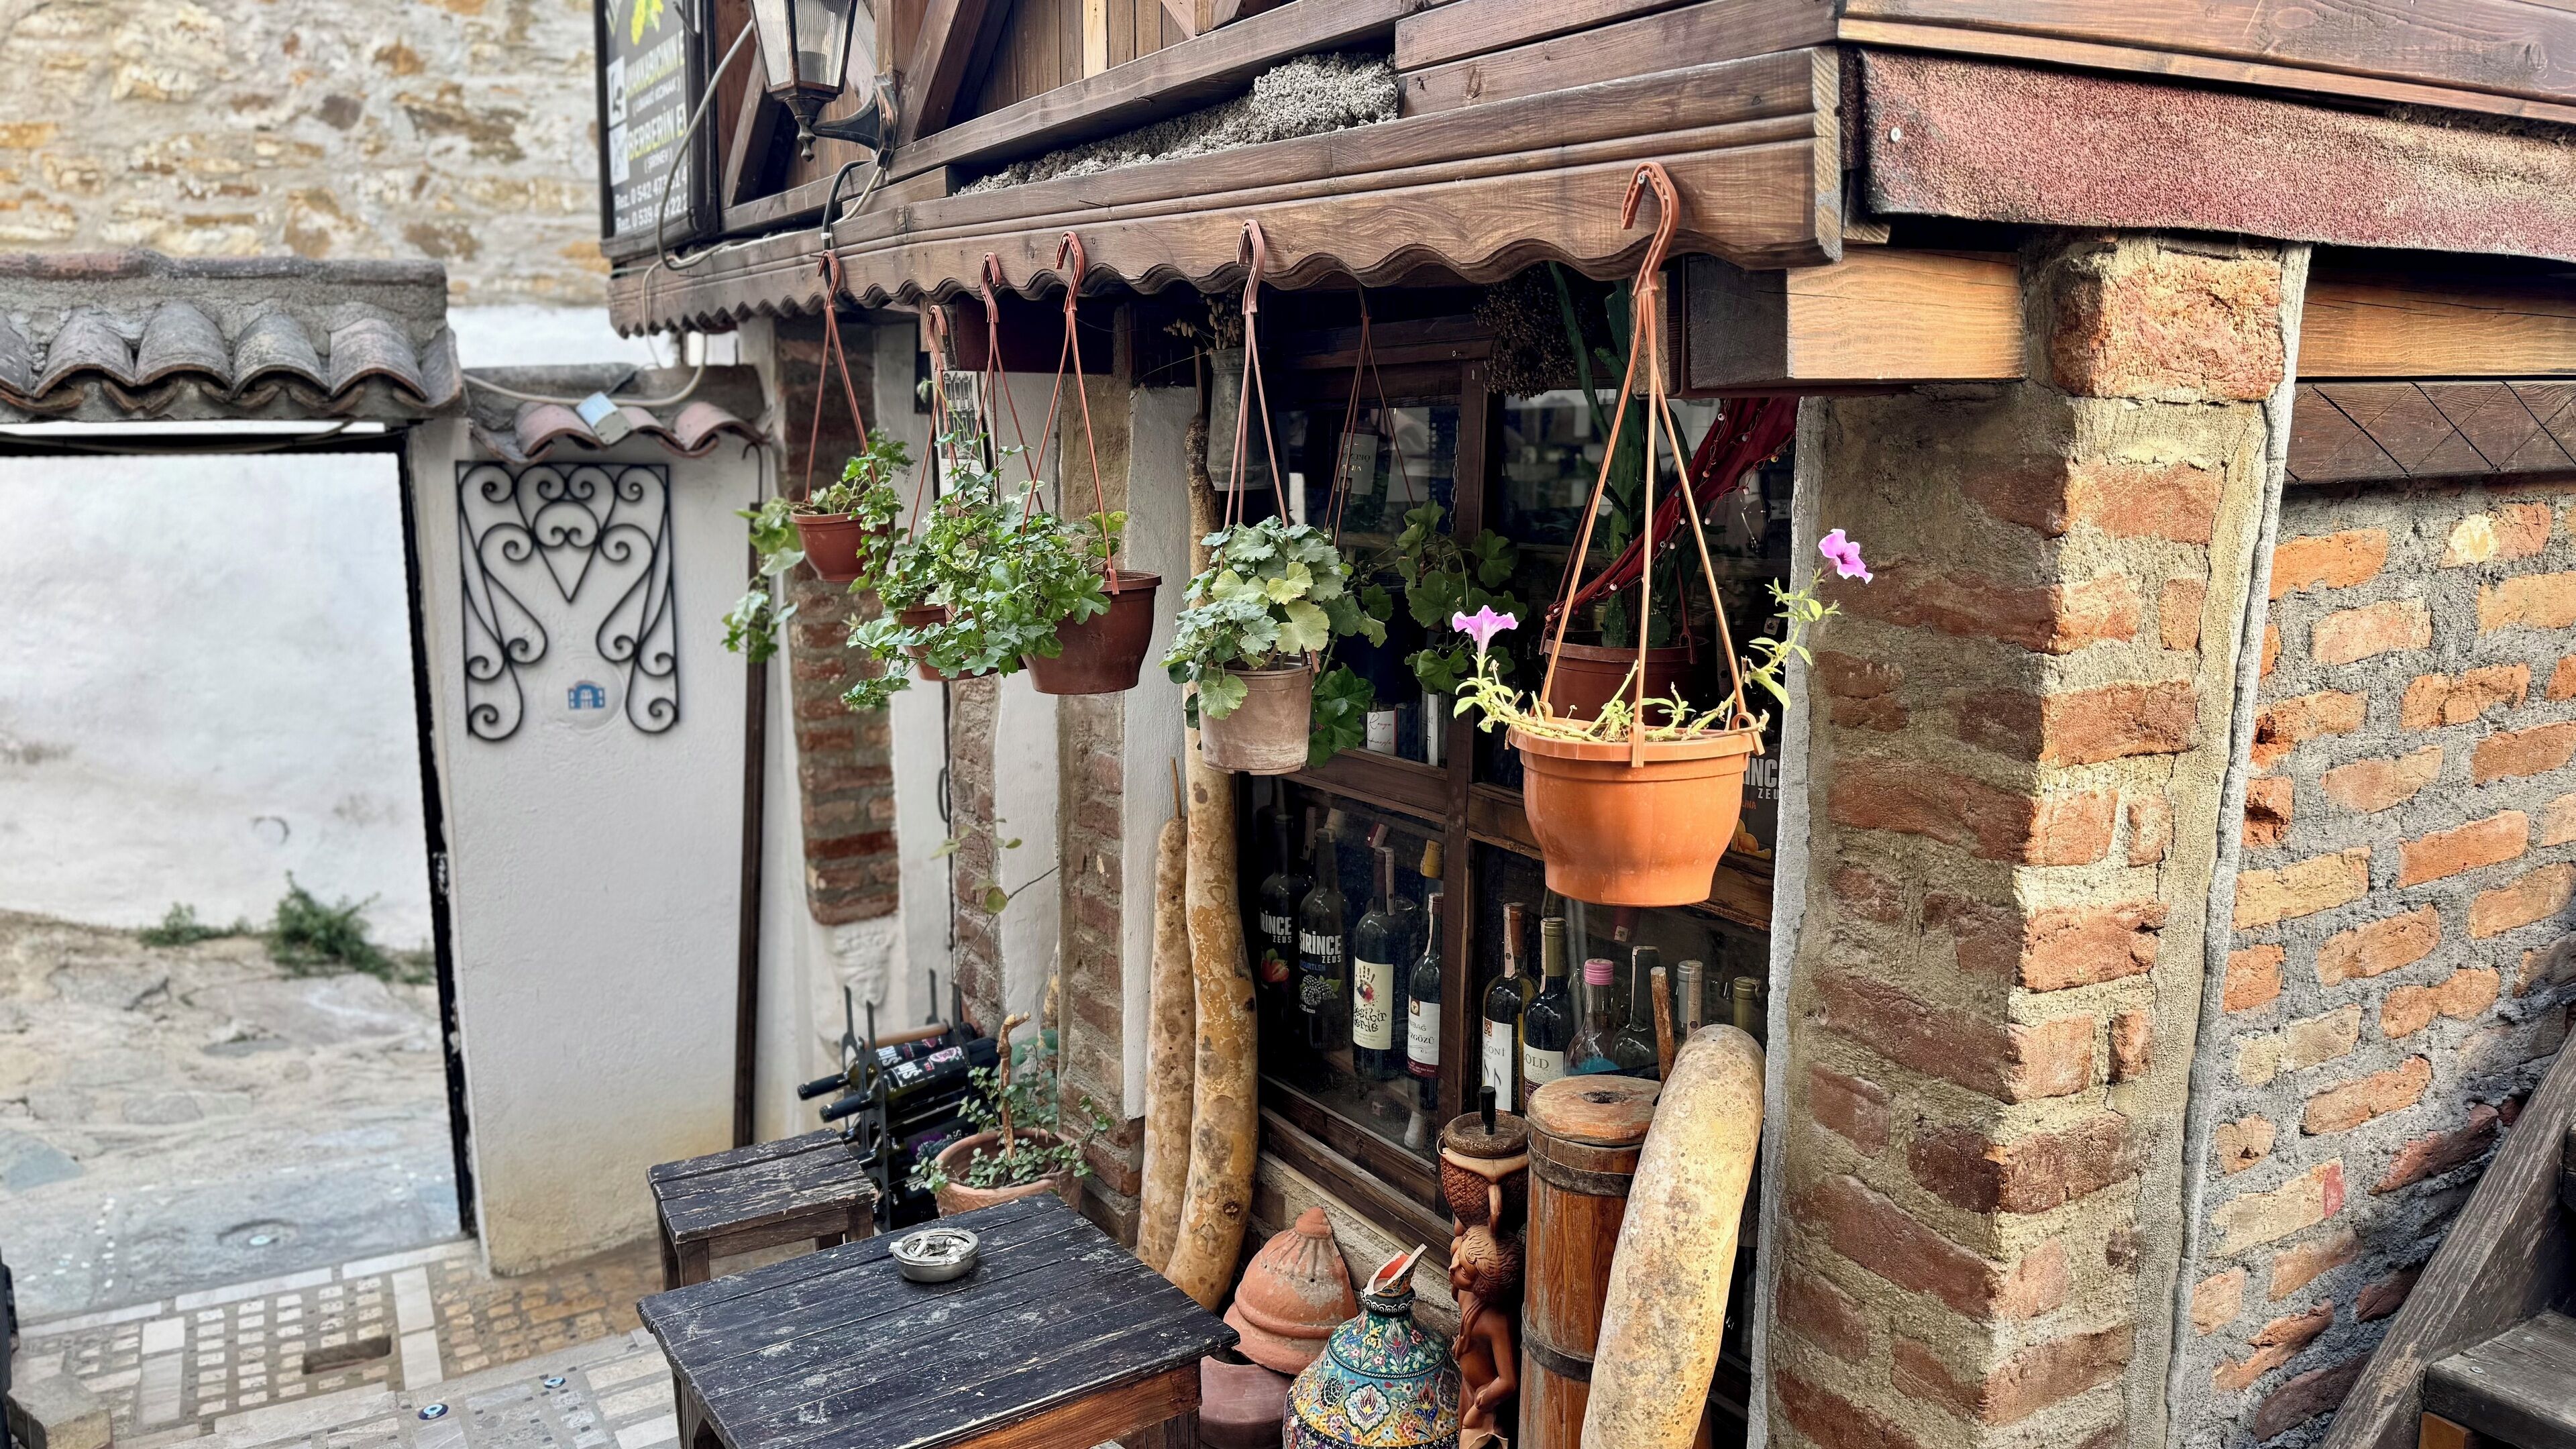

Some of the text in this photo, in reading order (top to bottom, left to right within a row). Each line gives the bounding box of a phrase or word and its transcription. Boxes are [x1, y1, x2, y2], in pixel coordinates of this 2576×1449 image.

[1273, 935, 1291, 943] ZEUS
[1322, 955, 1341, 963] ZEUS
[1523, 1053, 1550, 1070] OLD
